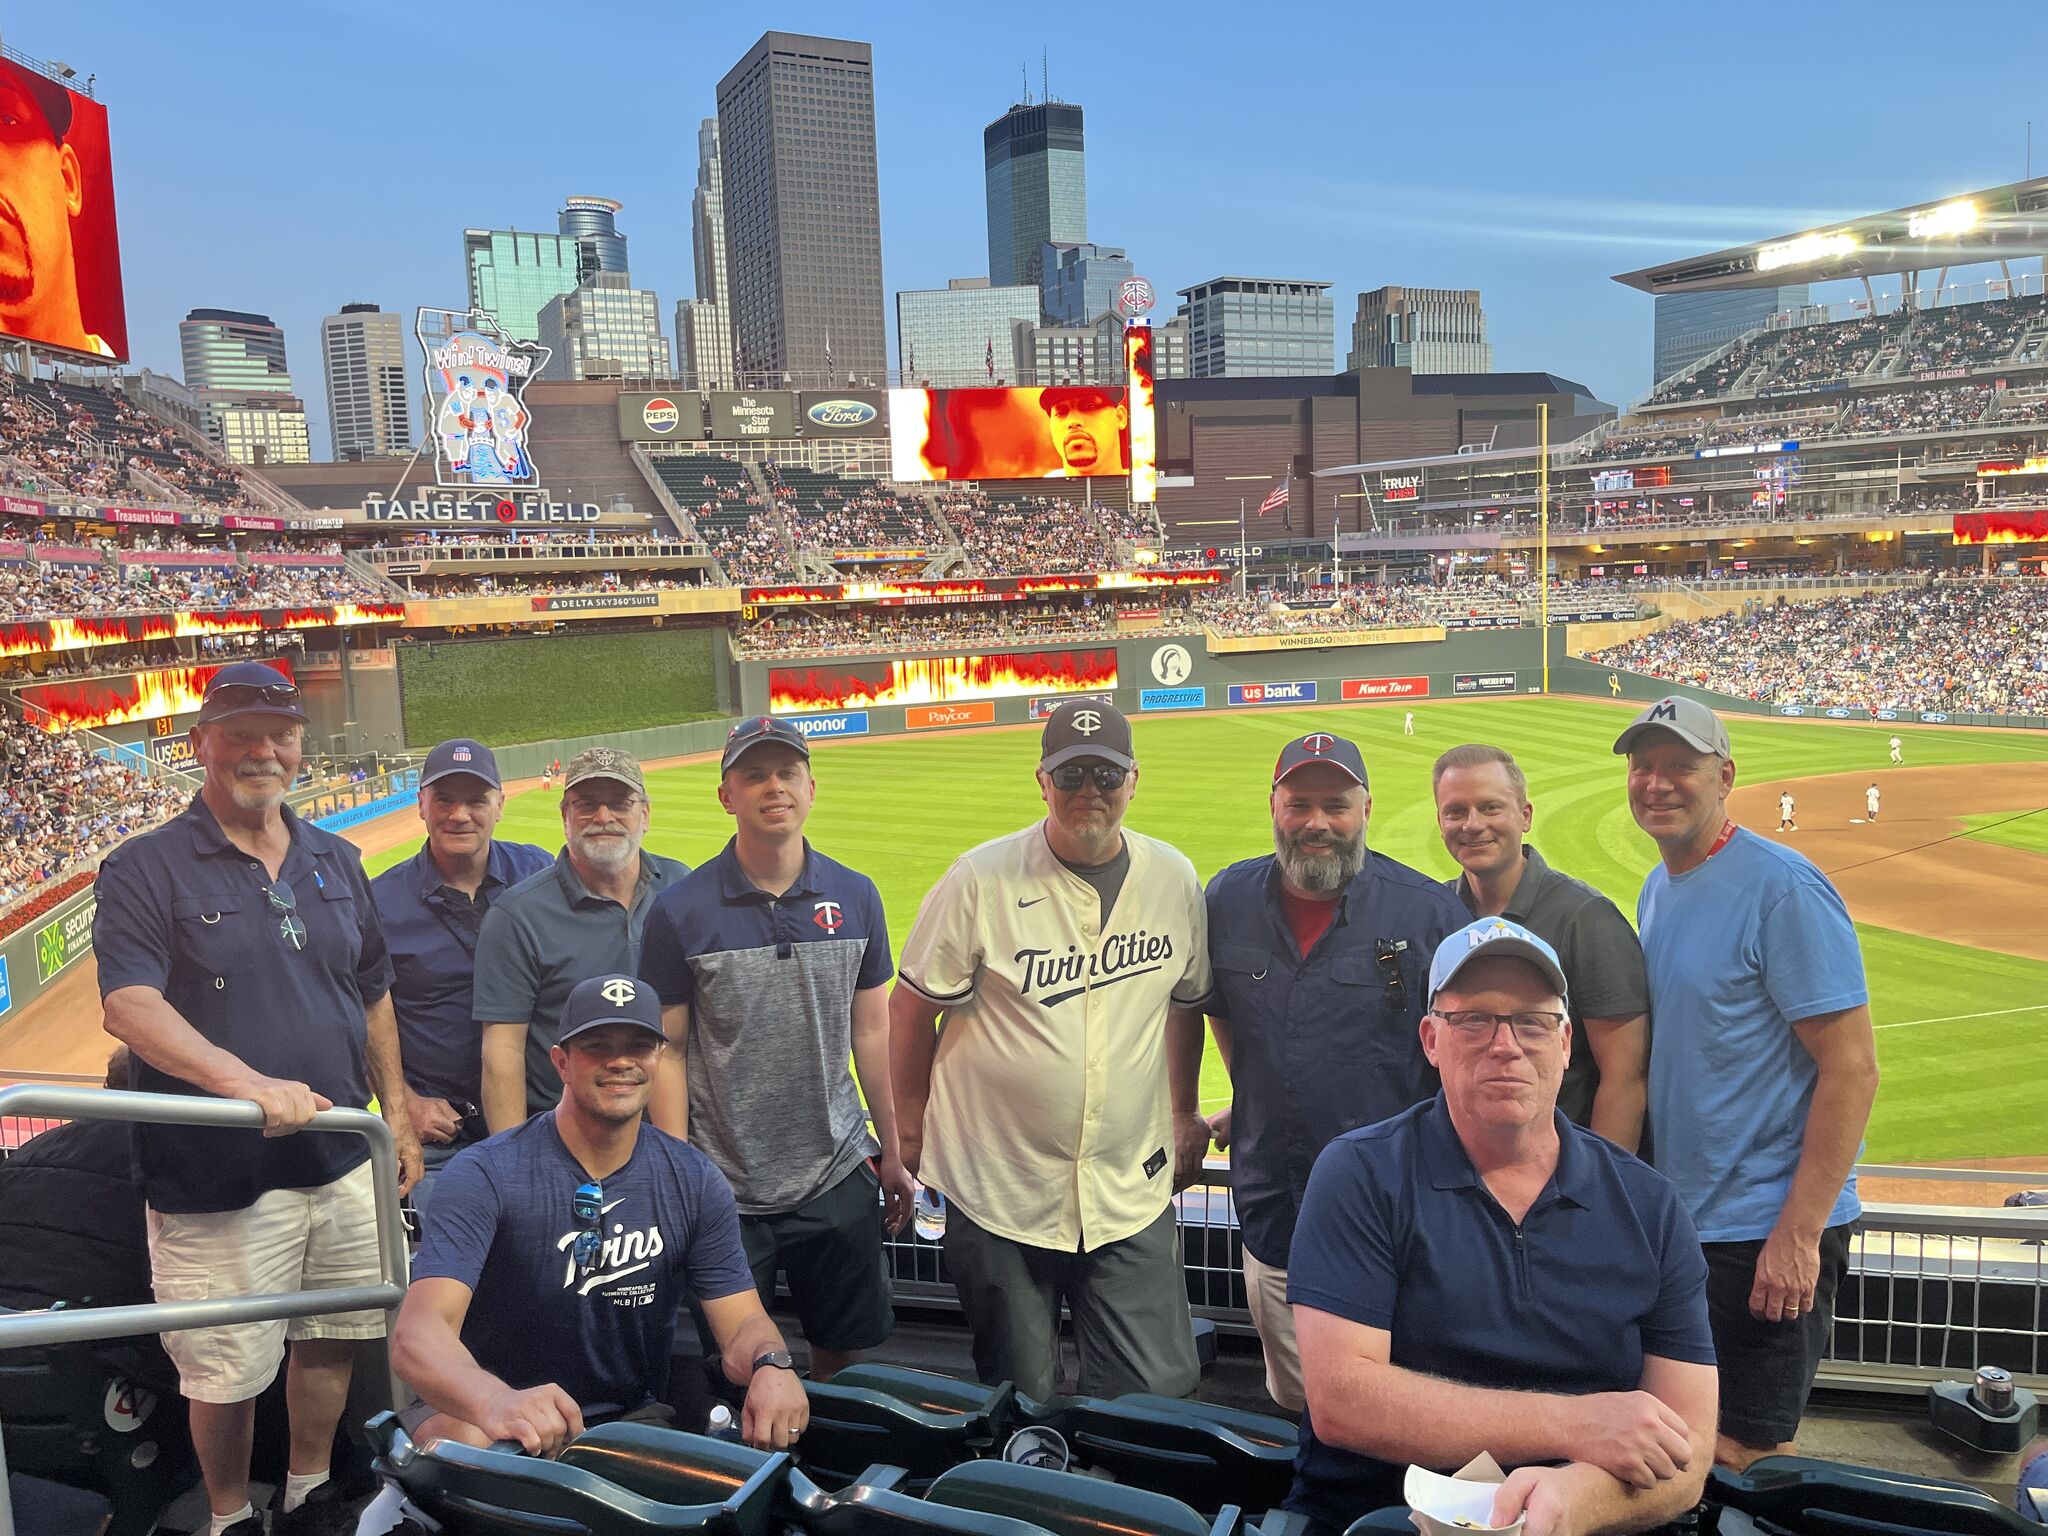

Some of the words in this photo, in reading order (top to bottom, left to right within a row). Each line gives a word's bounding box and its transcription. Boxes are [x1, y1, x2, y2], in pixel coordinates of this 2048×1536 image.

[434, 346, 474, 370] Win!
[476, 347, 532, 375] Twins!
[1921, 372, 1936, 380] END
[1936, 368, 1966, 379] RACISM
[741, 398, 757, 407] The
[646, 412, 677, 420] PEPSI
[732, 406, 775, 416] Minnesota
[821, 405, 863, 423] Ford
[752, 416, 770, 425] Star
[740, 424, 770, 434] Tribune
[1383, 476, 1419, 490] TRULY
[114, 509, 151, 523] Treasure
[151, 511, 174, 524] Island
[367, 499, 492, 520] TARGET
[522, 502, 601, 521] FIELD
[904, 595, 940, 605] UNIVERSAL
[943, 594, 968, 603] SPORTS
[971, 593, 1002, 602] AUCTIONS
[1280, 636, 1332, 646] WINNEBAGO
[1332, 634, 1387, 643] INDUSTRIES
[1244, 689, 1261, 699] us
[1358, 683, 1387, 694] KWIK
[1388, 682, 1413, 693] TRIP
[1143, 693, 1202, 704] PROGRESSIVE
[928, 708, 973, 723] Paycor
[1647, 705, 1676, 721] M
[794, 717, 848, 736] uponor
[65, 902, 97, 940] securi
[812, 902, 843, 934] TC
[67, 926, 92, 955] FINANCIA
[1014, 944, 1098, 995] Twin
[1101, 930, 1173, 975] Cities
[601, 979, 636, 1007] TC
[629, 1287, 656, 1295] COLLECTION
